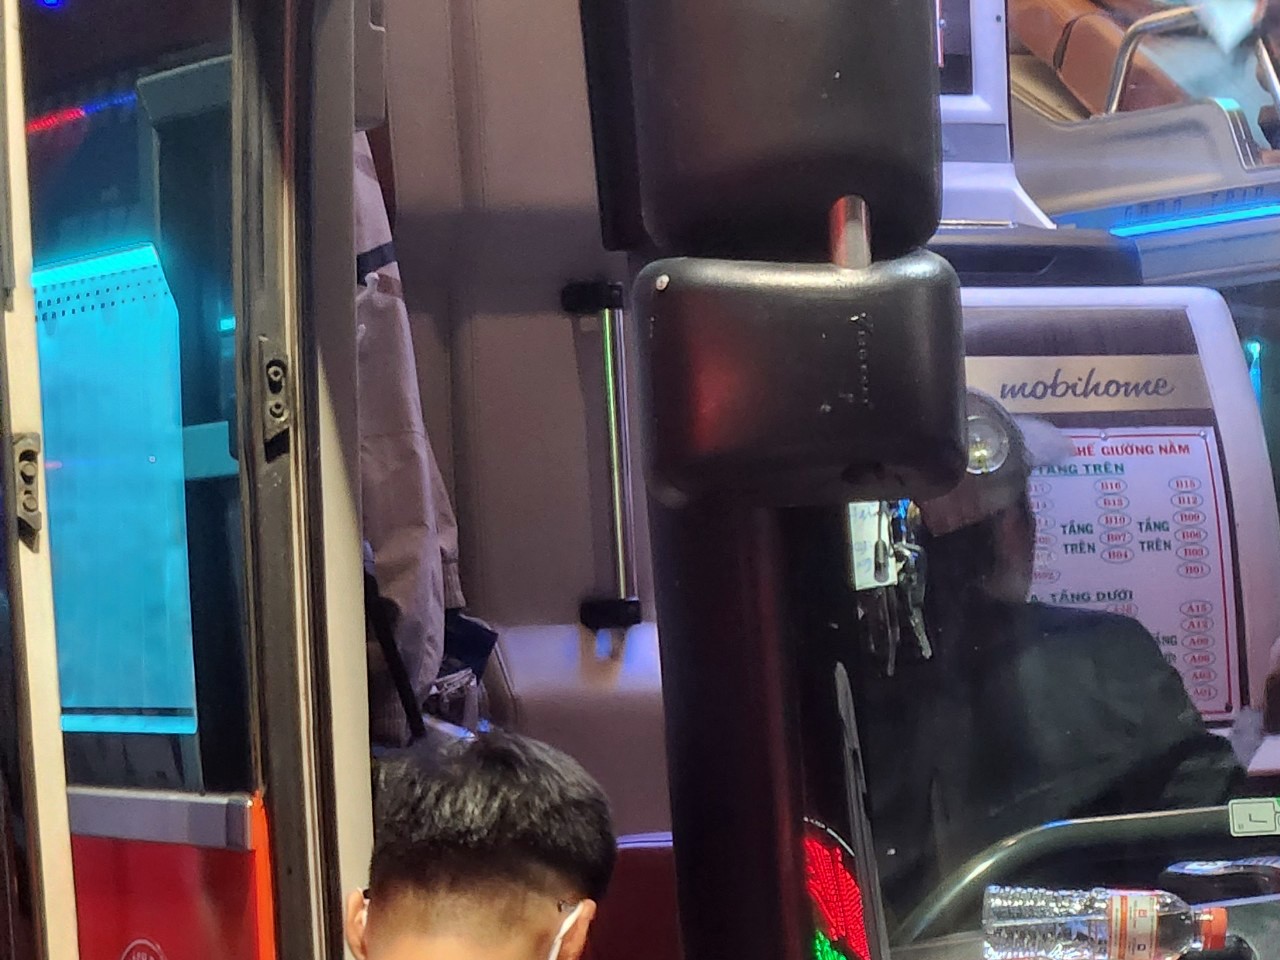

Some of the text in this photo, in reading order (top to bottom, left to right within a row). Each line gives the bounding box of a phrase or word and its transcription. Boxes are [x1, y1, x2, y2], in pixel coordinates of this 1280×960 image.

[999, 367, 1175, 401] mobihome
[1083, 460, 1126, 475] TRÊN
[1063, 539, 1096, 555] TRÊN
[1138, 537, 1172, 552] TRÊN
